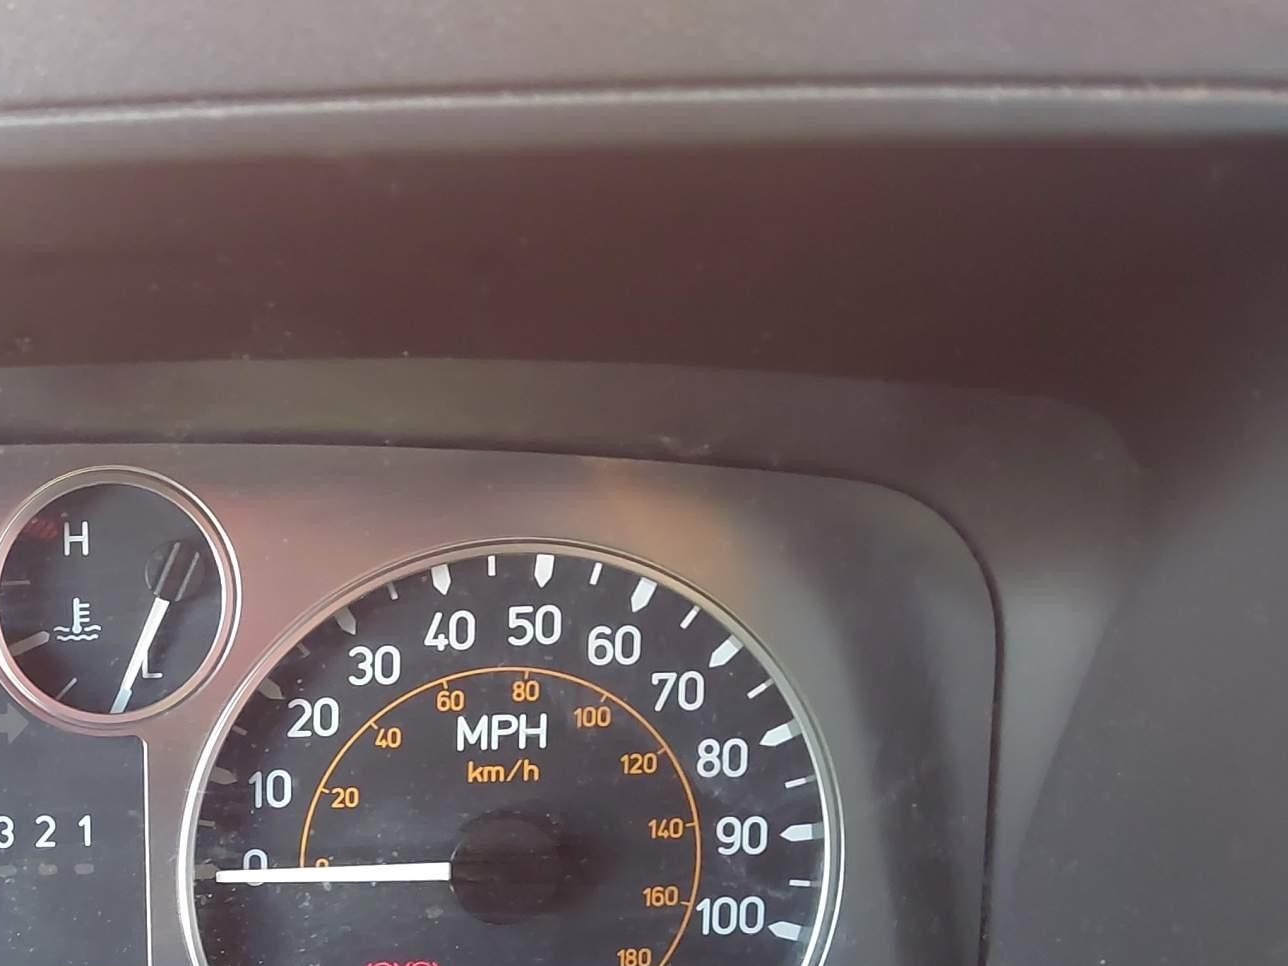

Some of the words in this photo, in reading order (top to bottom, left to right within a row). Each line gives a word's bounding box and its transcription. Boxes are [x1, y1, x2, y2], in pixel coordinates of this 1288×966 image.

[63, 521, 89, 556] H
[424, 610, 476, 651] 40
[508, 604, 562, 646] 50
[587, 625, 641, 667] 60
[348, 645, 401, 686] 30
[435, 687, 464, 713] 60
[511, 680, 540, 702] 80
[651, 671, 704, 712] 70
[288, 697, 340, 738] 20
[456, 714, 548, 753] MPH
[573, 706, 612, 729] 100
[374, 727, 402, 749] 40
[466, 760, 540, 785] km/h
[620, 753, 657, 775] 120
[697, 738, 748, 779] 80
[249, 771, 292, 809] 10
[330, 787, 359, 809] 20
[35, 815, 57, 848] 2
[78, 814, 92, 847] 1
[649, 818, 684, 840] 140
[715, 815, 768, 856] 90
[243, 848, 268, 887] 0
[642, 887, 678, 907] 160
[695, 895, 765, 936] 100
